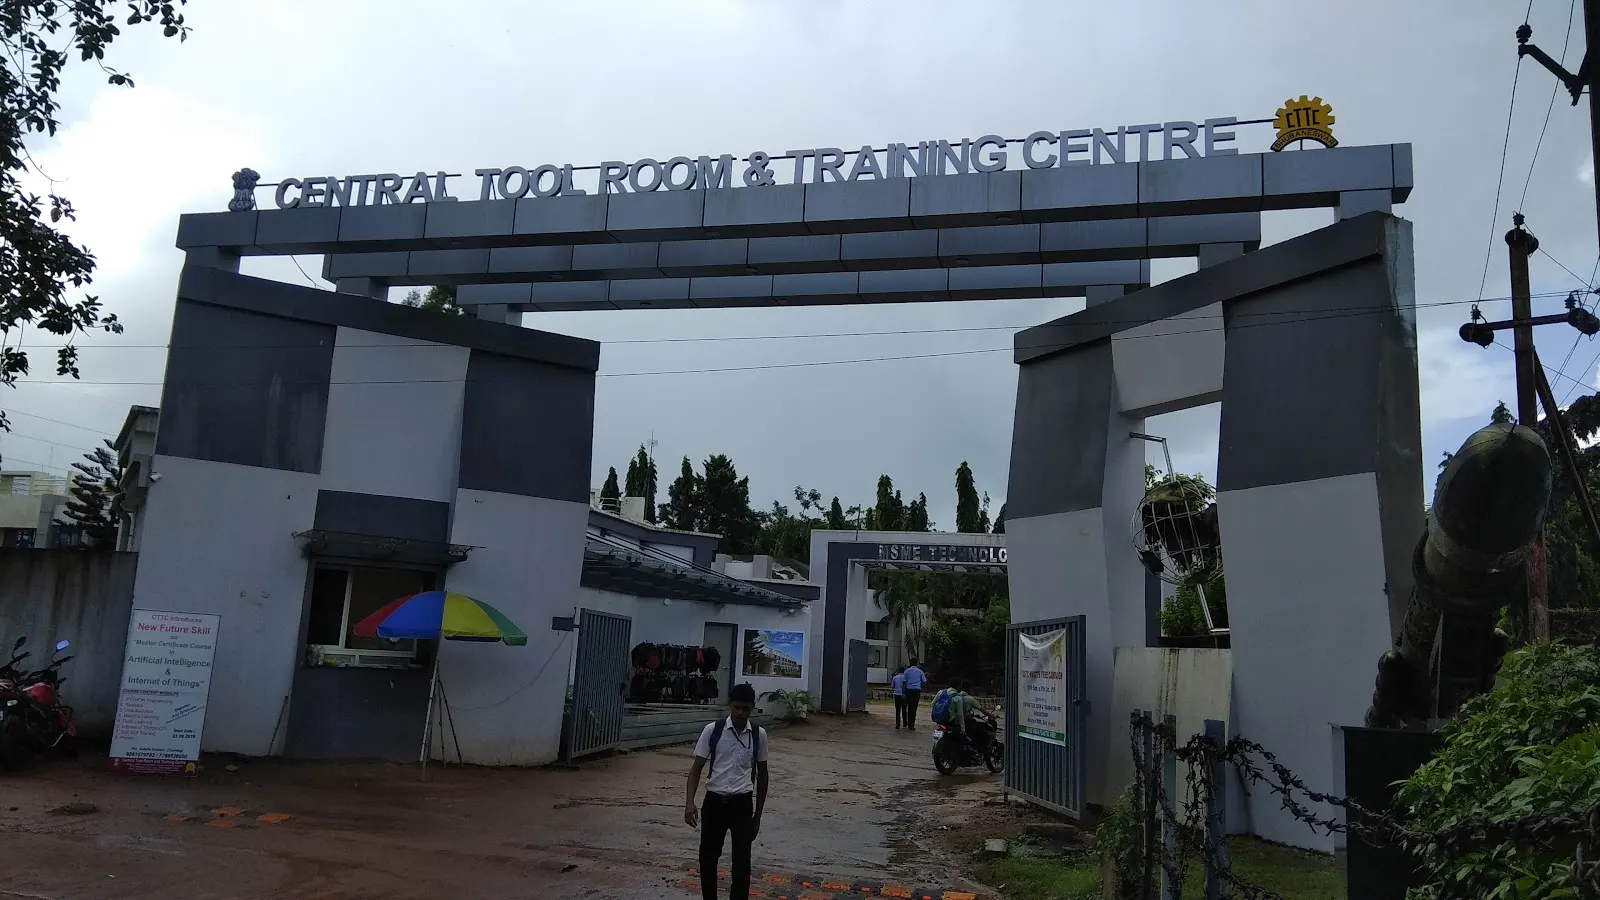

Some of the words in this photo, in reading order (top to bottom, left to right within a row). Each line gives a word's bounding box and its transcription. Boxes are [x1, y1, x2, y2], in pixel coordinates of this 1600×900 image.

[1286, 107, 1320, 128] CTTC
[1274, 129, 1335, 149] BHUBANESWAR
[274, 171, 459, 210] CENTRAL
[475, 163, 586, 201] TOOL
[599, 154, 737, 195] ROOM
[743, 150, 775, 188] &
[786, 134, 1008, 183] TRAINING
[1022, 116, 1240, 169] CENTRE
[929, 546, 1008, 562] TECHNOLO
[138, 623, 157, 632] New
[160, 624, 189, 633] Future
[191, 626, 211, 635] Skill
[128, 655, 163, 665] Artificial
[164, 658, 211, 668] Intelligence
[128, 676, 160, 685] Internet
[162, 678, 171, 686] of
